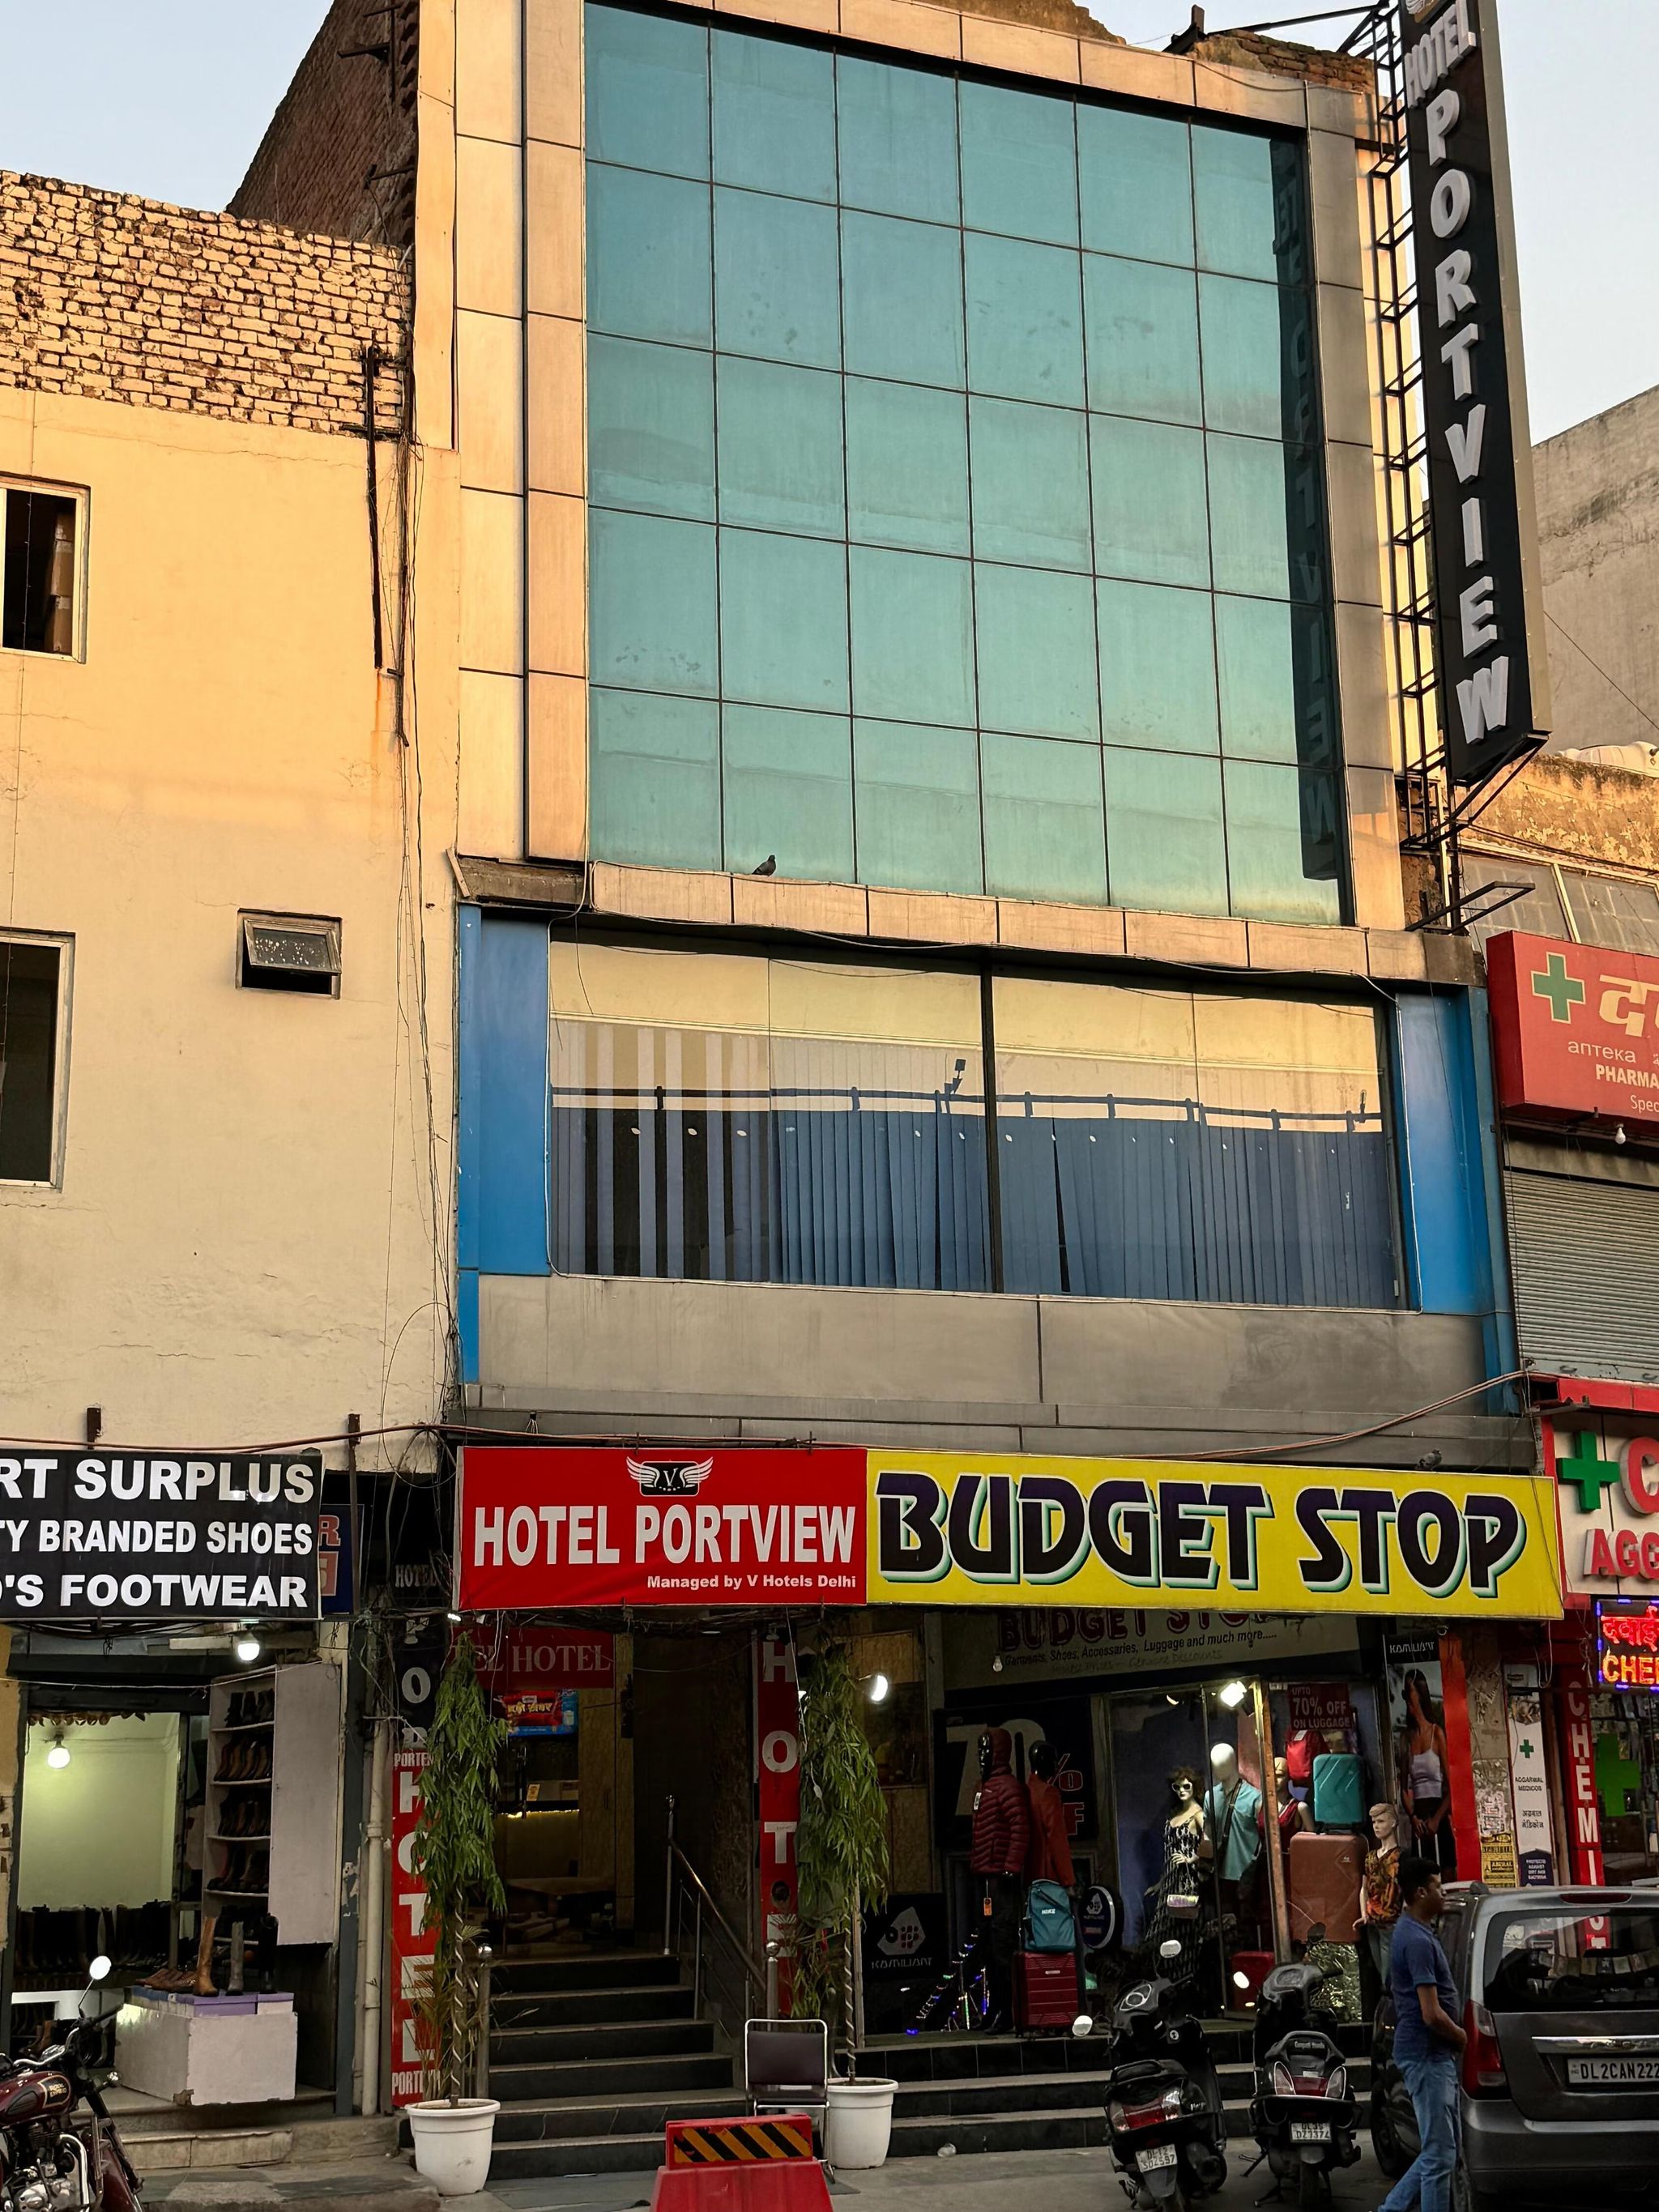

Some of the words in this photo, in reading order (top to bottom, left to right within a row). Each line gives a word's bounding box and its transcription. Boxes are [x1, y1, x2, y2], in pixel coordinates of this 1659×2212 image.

[1404, 0, 1477, 109] HOTEL
[1426, 89, 1510, 744] PORTVIEW
[1599, 974, 1659, 1037] द
[1567, 1040, 1636, 1063] аптека
[74, 1459, 315, 1503] SURPLUS
[0, 1519, 30, 1553] Y
[38, 1519, 197, 1553] BRANDED
[206, 1521, 313, 1555] SHOES
[474, 1505, 621, 1566] HOTEL
[635, 1504, 856, 1564] PORTVIEW
[875, 1470, 1275, 1591] BUDGET
[1294, 1485, 1528, 1600] STOP
[0, 1574, 44, 1608] 'S
[59, 1574, 309, 1608] FOOTWEAR
[647, 1575, 719, 1591] Managed
[723, 1575, 742, 1590] by
[747, 1575, 759, 1587] V
[763, 1575, 813, 1588] Hotels
[817, 1575, 856, 1588] Delhi
[1144, 1635, 1189, 1652] Luggage
[1187, 1634, 1205, 1647] and
[1207, 1632, 1235, 1645] much
[1601, 1606, 1659, 1652] दवाई
[512, 1644, 612, 1673] HOTEL
[1602, 1655, 1659, 1685] CHE
[1293, 1697, 1323, 1716] 70%
[1327, 1700, 1346, 1715] OFF
[1293, 1719, 1307, 1728] ON
[1308, 1717, 1350, 1728] LUGGAGE
